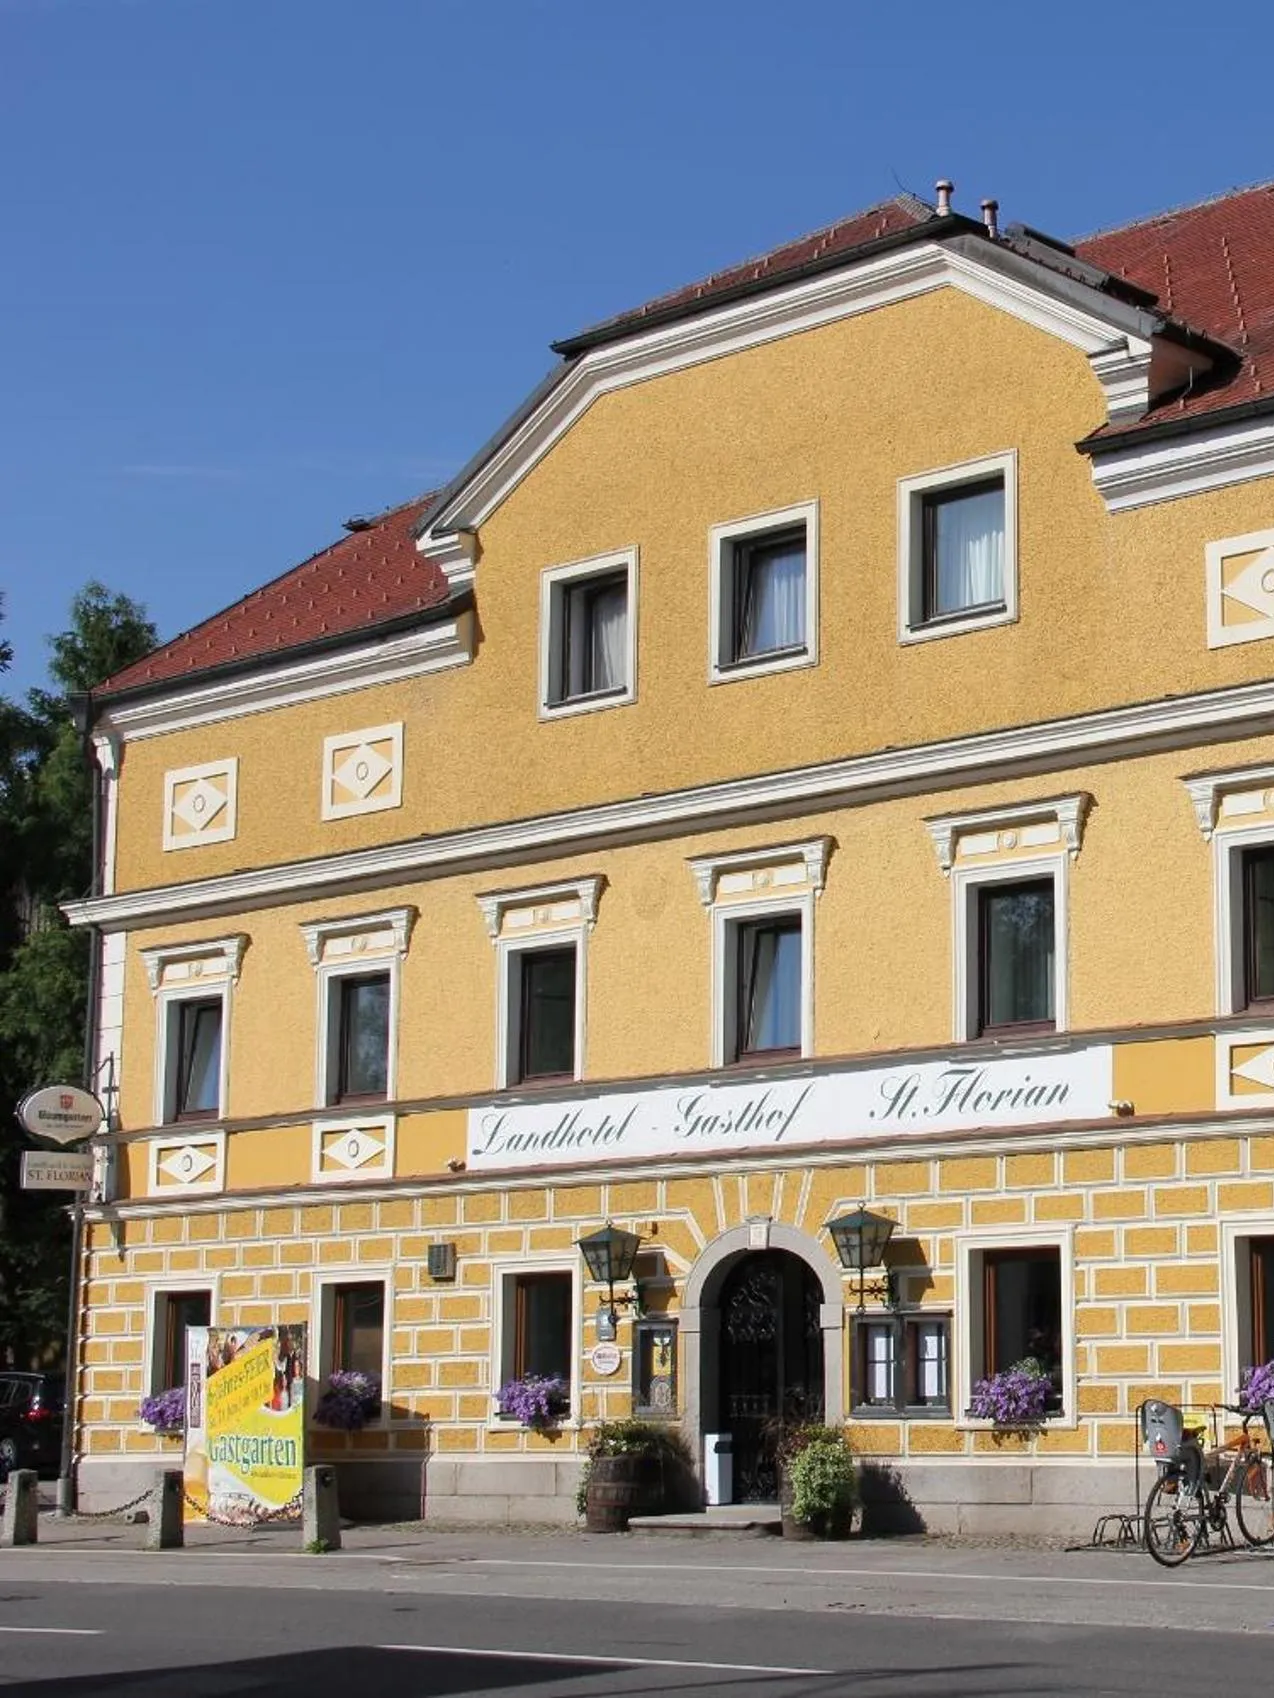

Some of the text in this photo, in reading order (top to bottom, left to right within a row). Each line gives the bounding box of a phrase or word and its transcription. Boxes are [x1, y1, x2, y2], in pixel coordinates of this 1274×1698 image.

[472, 1103, 638, 1155] Landhotel
[673, 1081, 815, 1142] Gasthof
[868, 1072, 921, 1121] St.
[922, 1066, 1070, 1117] Florian
[208, 1433, 297, 1475] Gastgarten
